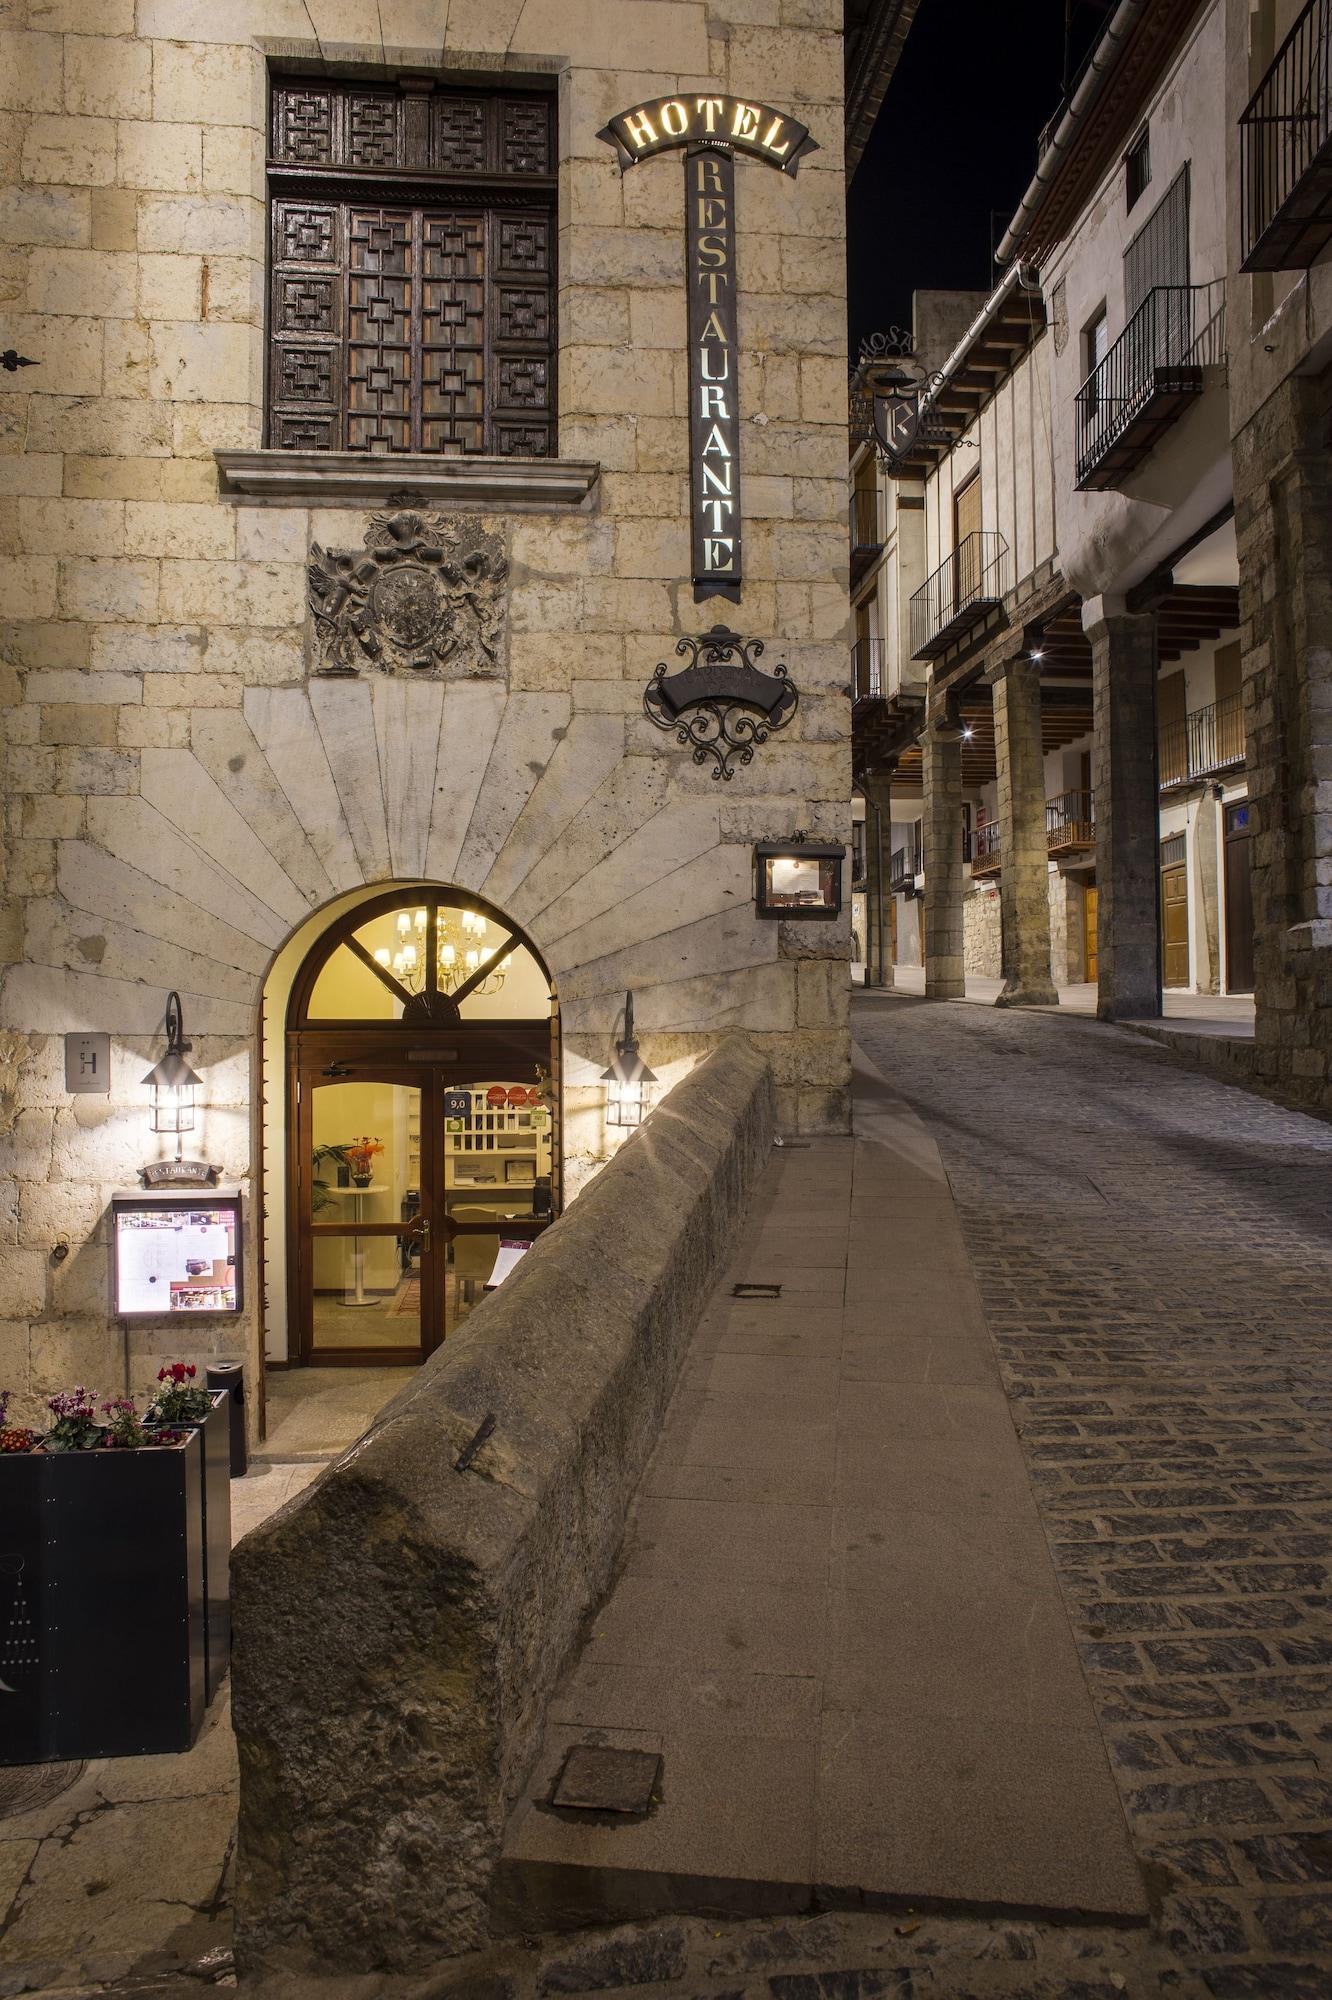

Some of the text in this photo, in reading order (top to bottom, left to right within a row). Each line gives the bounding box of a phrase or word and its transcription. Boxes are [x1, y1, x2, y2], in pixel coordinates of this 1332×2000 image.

[450, 100, 466, 110] 9,0
[623, 98, 790, 156] HOTEL
[697, 160, 734, 571] RESTAURANTE
